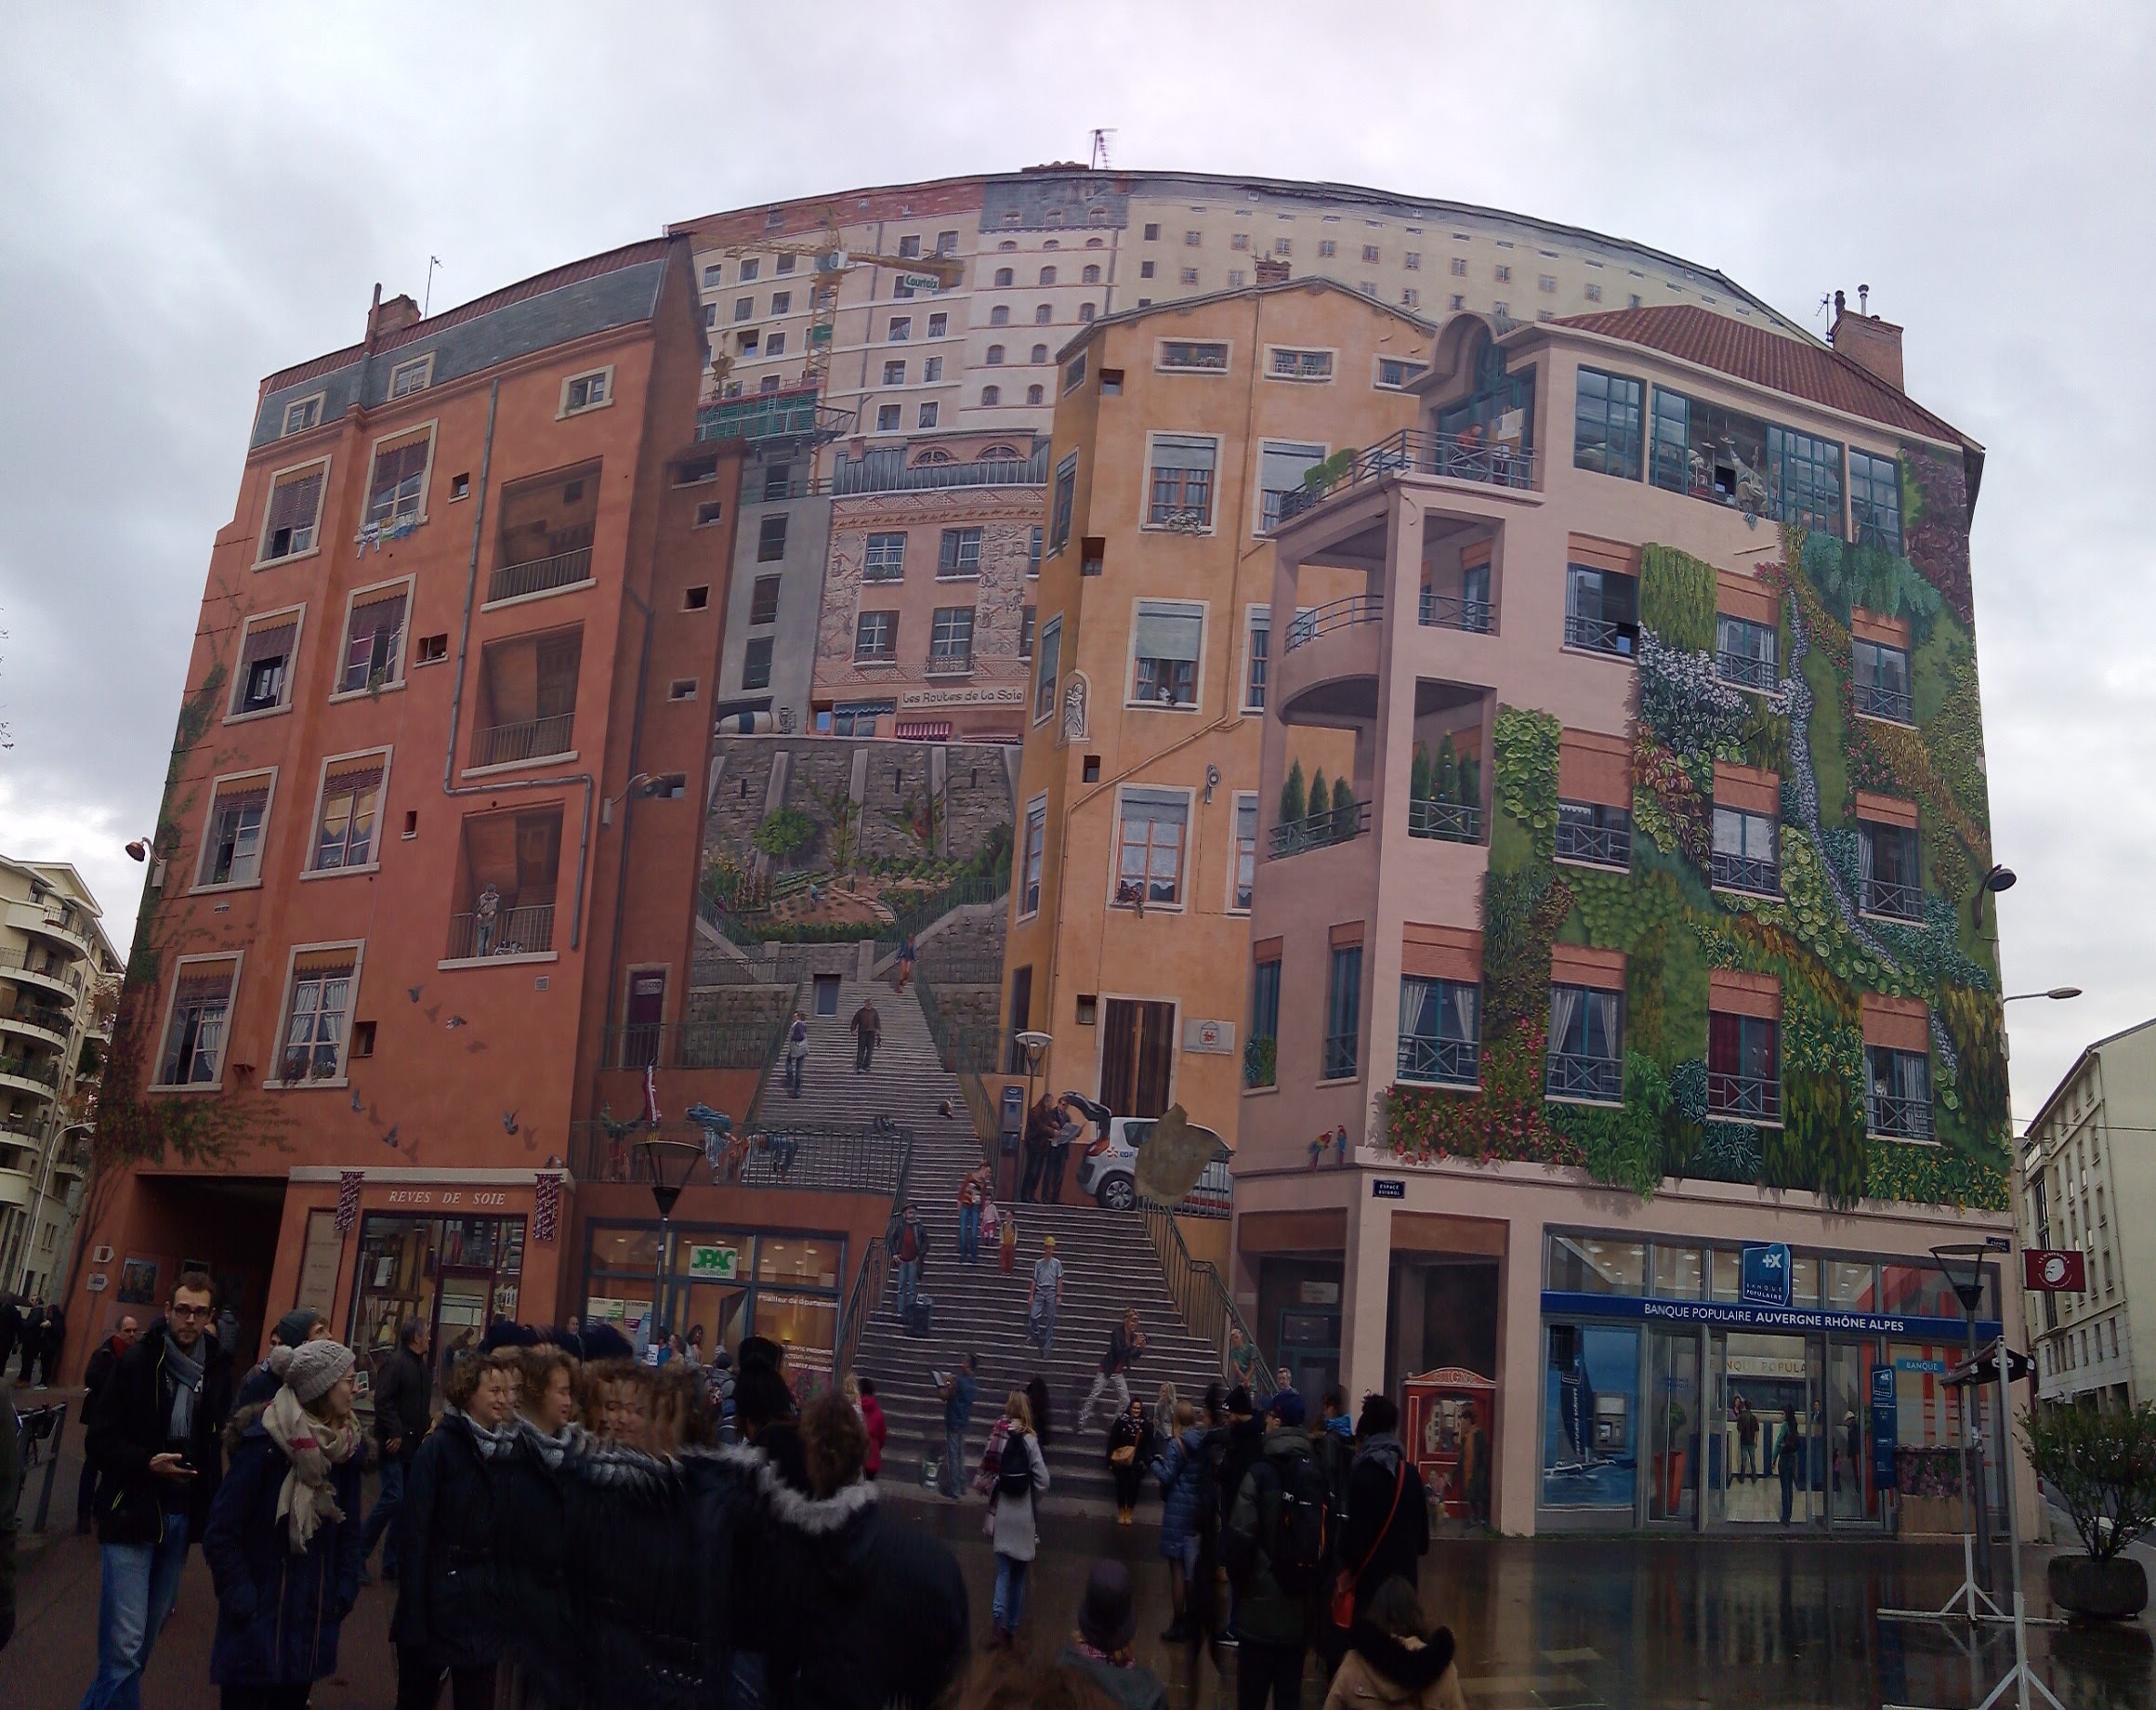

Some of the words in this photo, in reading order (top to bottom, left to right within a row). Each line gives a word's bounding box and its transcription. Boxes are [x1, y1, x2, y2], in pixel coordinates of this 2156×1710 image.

[923, 691, 963, 703] Routes
[965, 691, 979, 701] de
[997, 689, 1022, 700] Soie
[441, 1191, 462, 1204] DE
[472, 1192, 506, 1205] SOIE
[1746, 1282, 1782, 1293] BANQUE
[1746, 1289, 1783, 1301] POPULAIRE
[1644, 1303, 1689, 1319] BANQUE
[1692, 1307, 1752, 1322] POPULAIRE
[1755, 1311, 1821, 1326] AUVERGNE
[1824, 1315, 1866, 1329] RHÔNE
[1869, 1320, 1904, 1332] ALPES
[1905, 1361, 1939, 1372] BANQUE
